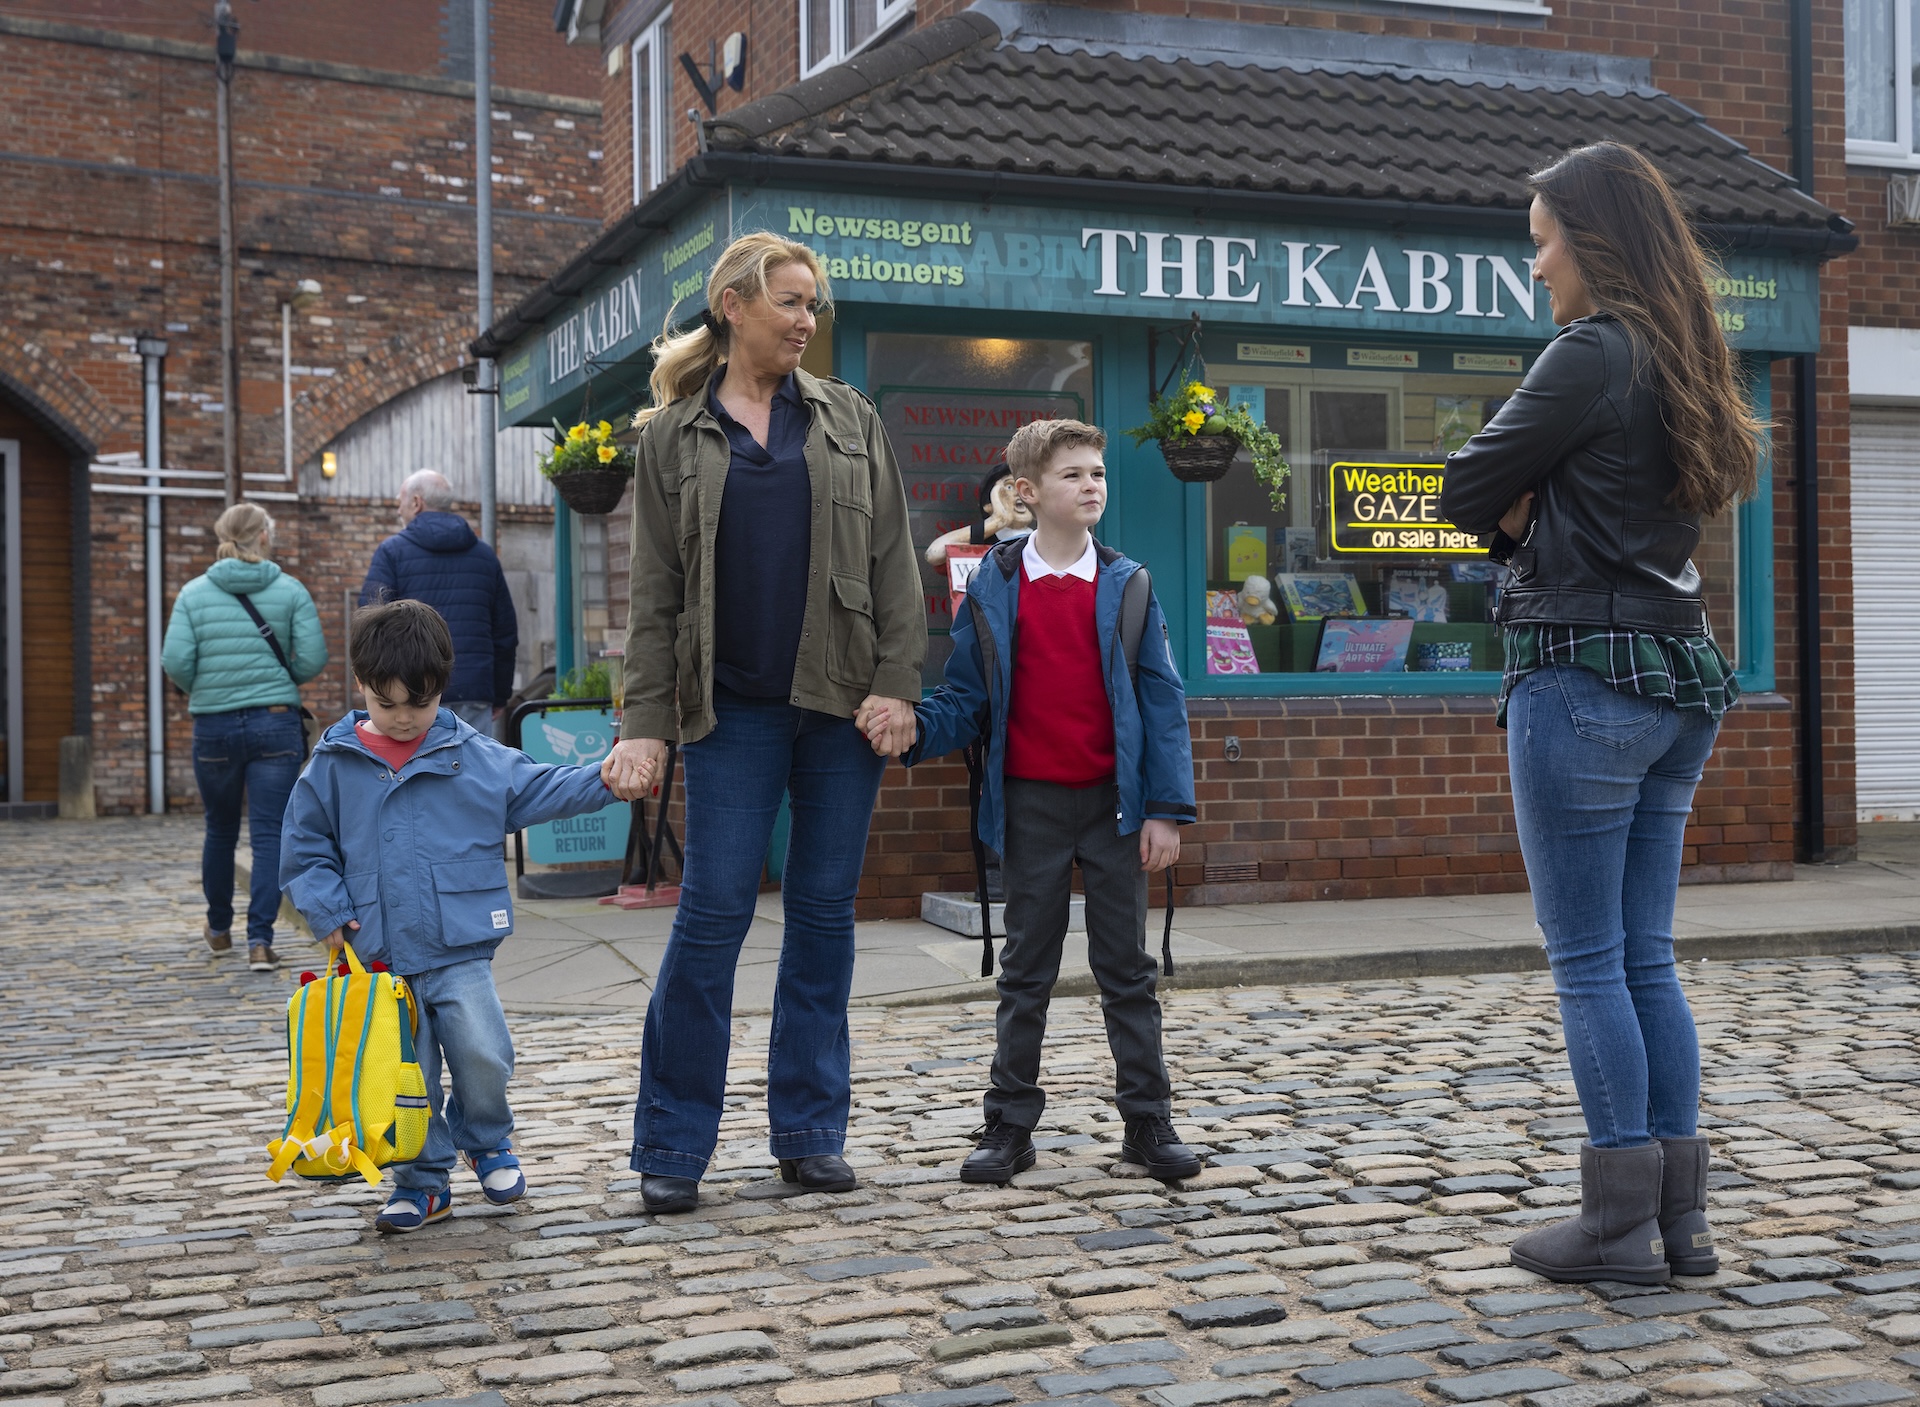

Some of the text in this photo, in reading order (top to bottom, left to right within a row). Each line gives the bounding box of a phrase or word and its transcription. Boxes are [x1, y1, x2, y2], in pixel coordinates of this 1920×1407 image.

[788, 207, 973, 247] Newsagent
[662, 220, 714, 275] Tobacconist
[814, 250, 965, 286] tationers
[1082, 227, 1260, 303] THE
[1281, 241, 1536, 322] KABIN
[672, 269, 703, 305] Sweets
[547, 268, 642, 385] THE KABIN
[1251, 347, 1295, 358] Weatherfield
[1361, 352, 1403, 363] Weatherfield
[1466, 356, 1507, 366] Weatherfield
[911, 481, 969, 501] GIFT
[1353, 493, 1445, 522] GAZE
[1371, 529, 1479, 548] on sale here
[1344, 642, 1386, 652] ULTIMATE
[1344, 652, 1381, 663] ART SET
[552, 816, 607, 834] COLLECT
[555, 836, 606, 853] RETURN
